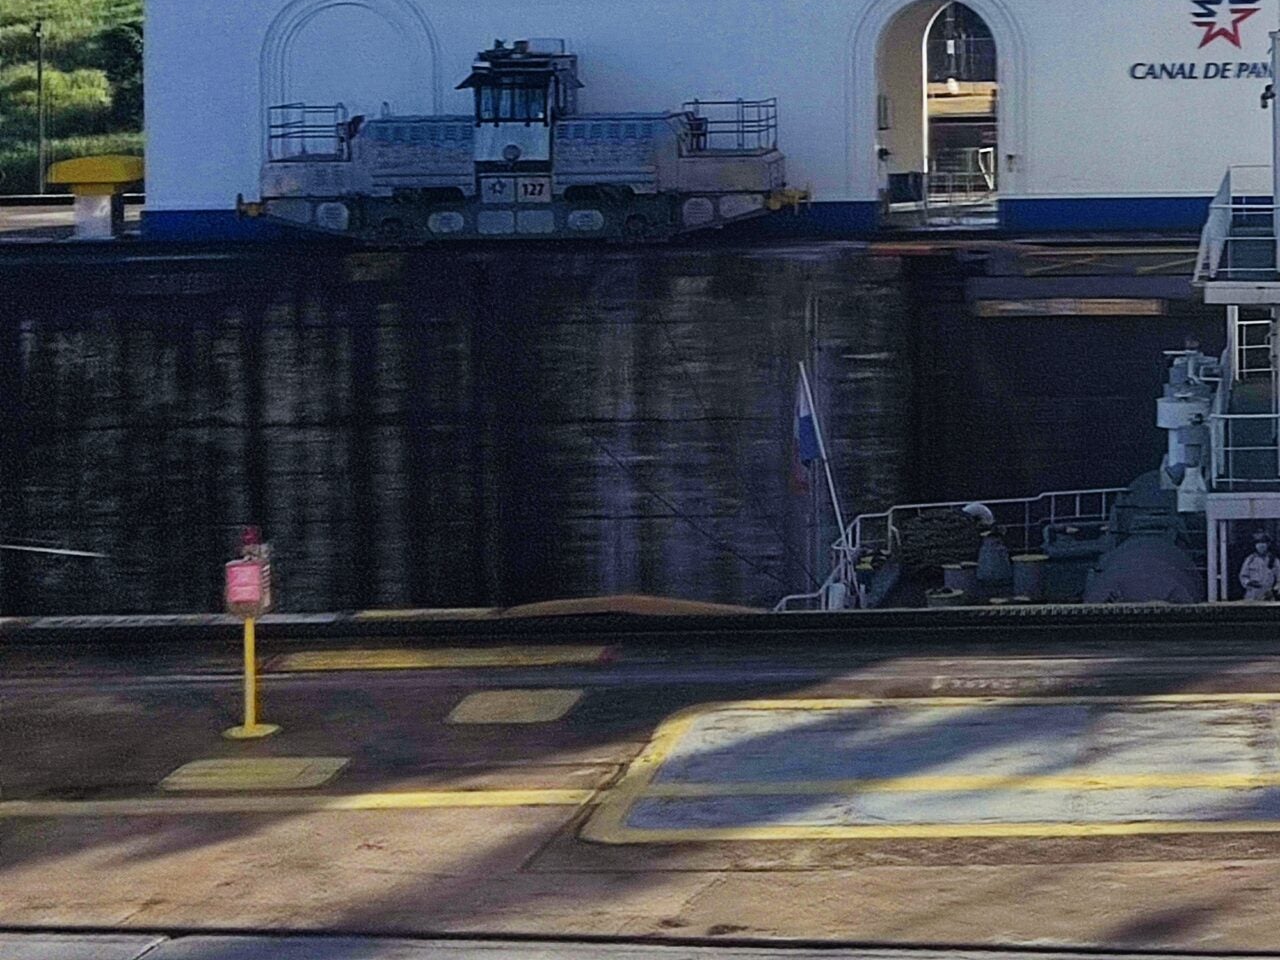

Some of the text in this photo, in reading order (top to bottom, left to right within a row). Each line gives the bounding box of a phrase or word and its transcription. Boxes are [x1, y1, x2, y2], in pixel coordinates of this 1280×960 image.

[1130, 61, 1199, 80] CANAL
[1203, 61, 1233, 79] DE
[521, 182, 545, 197] 127
